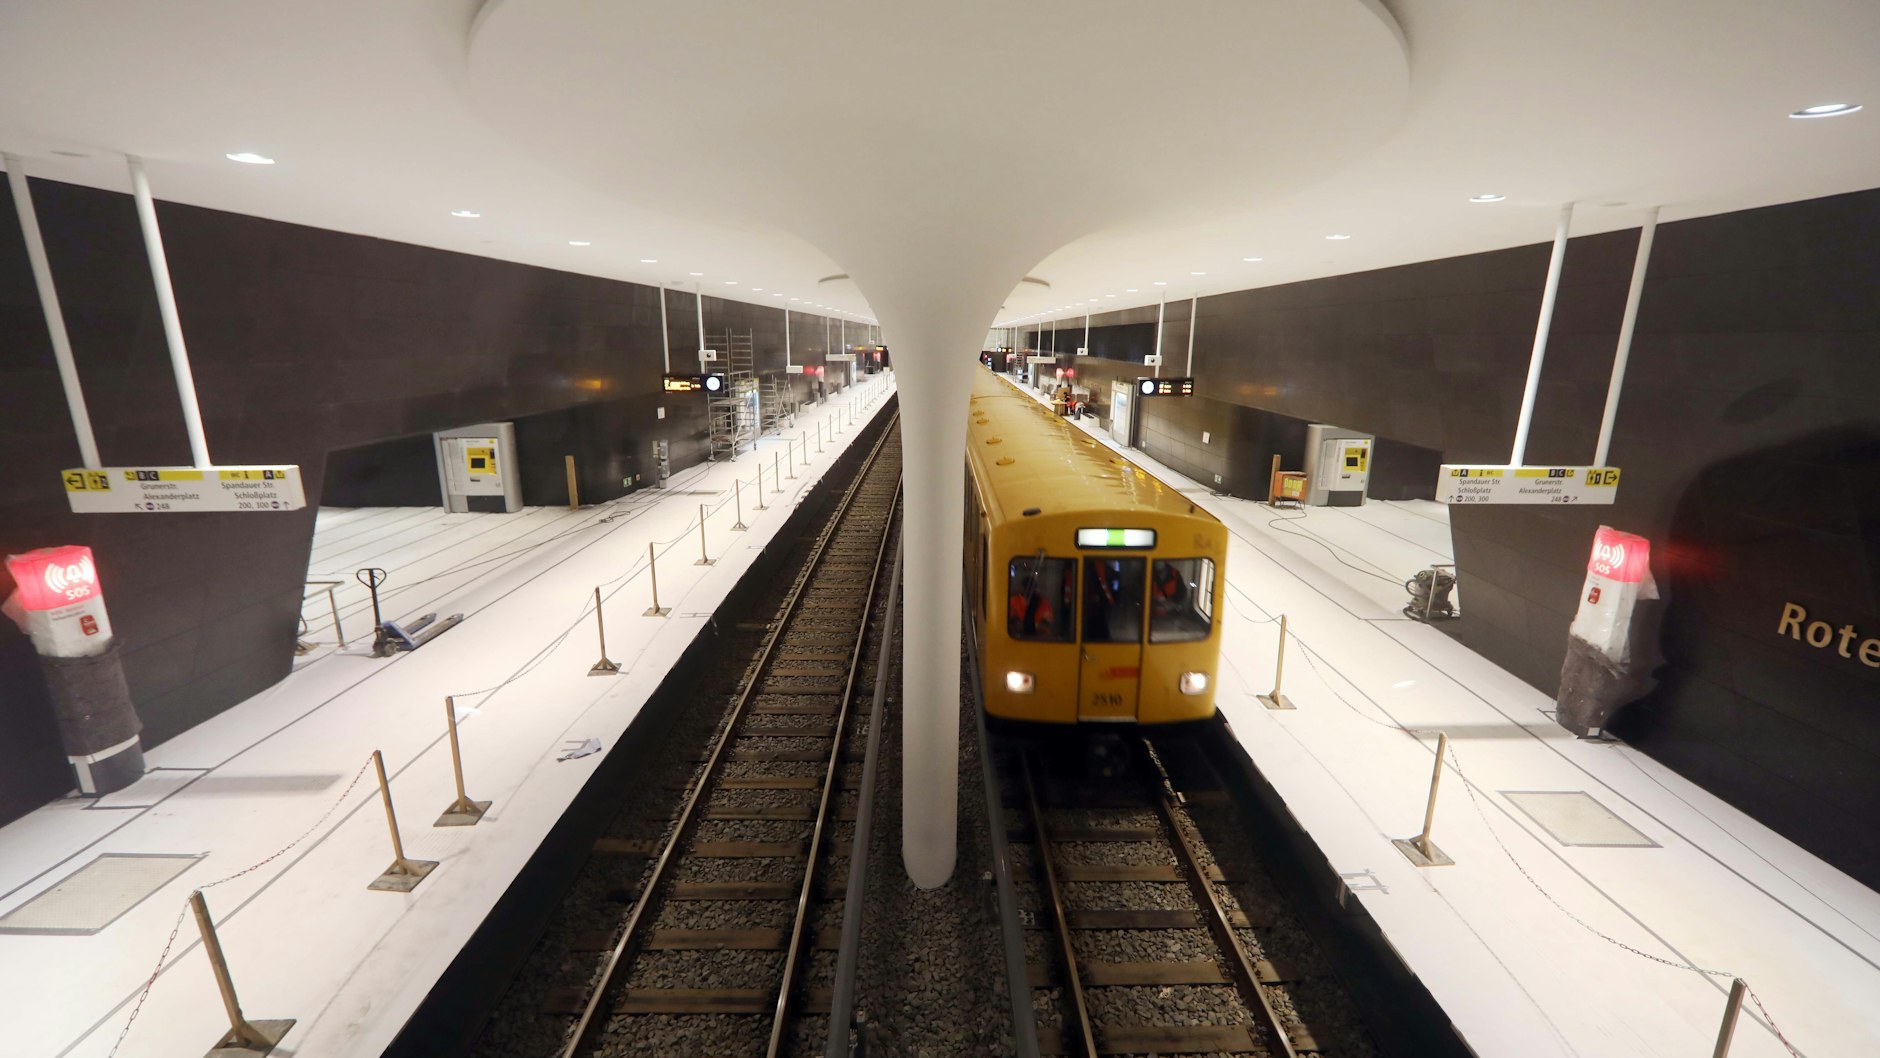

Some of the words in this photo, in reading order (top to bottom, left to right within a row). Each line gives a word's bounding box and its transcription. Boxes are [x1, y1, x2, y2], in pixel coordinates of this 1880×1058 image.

[221, 482, 261, 491] Spandauer
[1458, 487, 1492, 495] Schloßplatz
[1518, 487, 1562, 495] Alexanderplatz
[143, 493, 200, 501] Alexanderplatz
[234, 492, 278, 500] Schloßplatz
[1594, 562, 1610, 574] SOS
[65, 586, 90, 600] SOS
[1777, 602, 1880, 668] Rote
